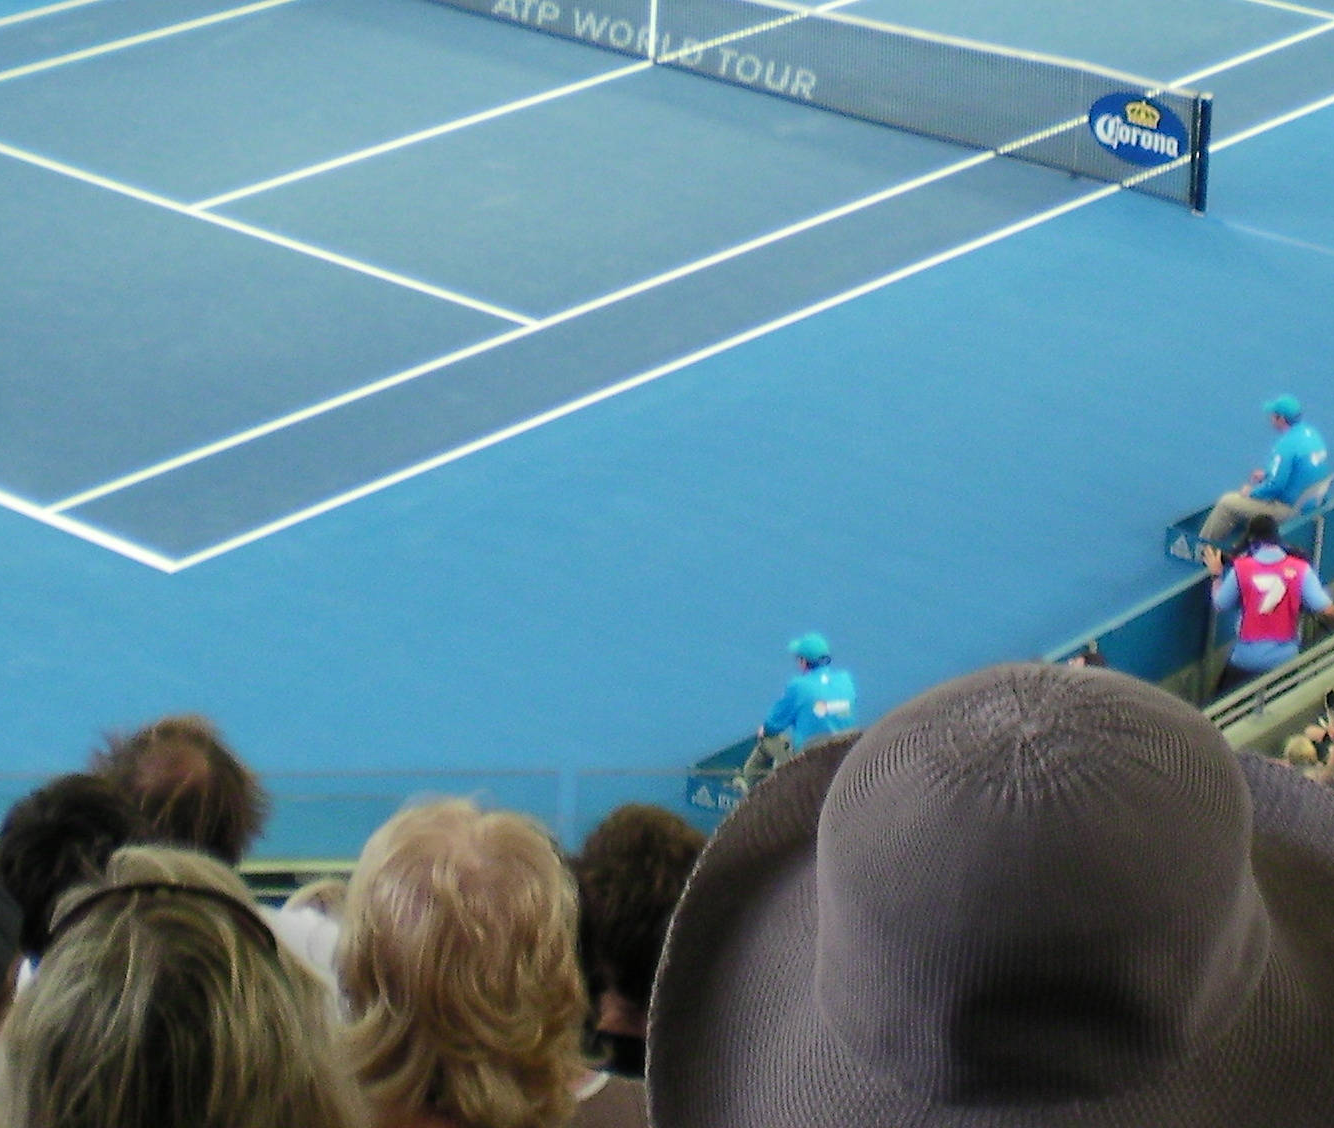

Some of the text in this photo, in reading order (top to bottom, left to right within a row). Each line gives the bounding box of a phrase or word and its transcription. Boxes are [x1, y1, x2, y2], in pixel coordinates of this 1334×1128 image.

[572, 7, 702, 67] WORLD
[718, 48, 818, 101] TOUR
[1095, 112, 1179, 158] Corona
[1251, 573, 1287, 615] 7
